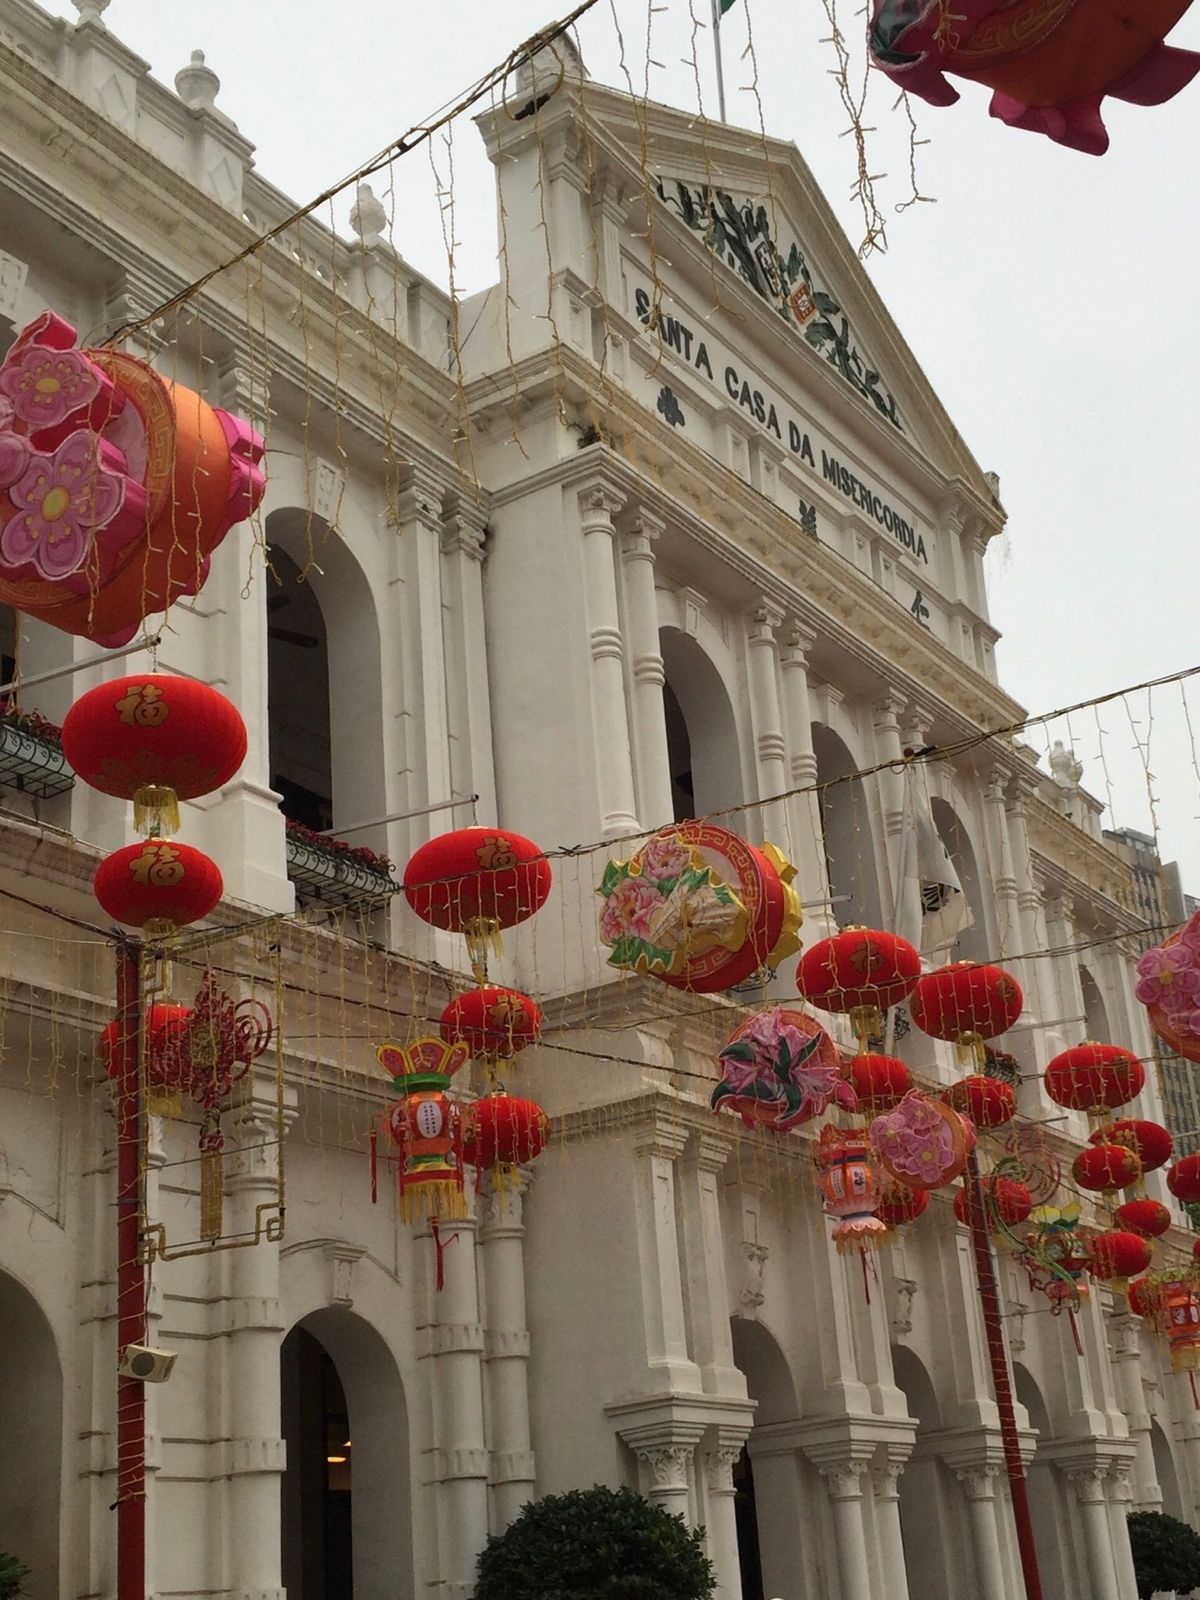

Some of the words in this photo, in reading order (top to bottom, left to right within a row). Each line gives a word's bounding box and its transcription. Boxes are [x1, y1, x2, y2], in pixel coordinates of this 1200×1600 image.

[725, 366, 781, 440] CASA
[789, 420, 815, 467] DA
[822, 449, 928, 564] MISERICORDIA
[115, 683, 170, 727] 福
[128, 845, 185, 886] 福
[476, 836, 518, 870] 福
